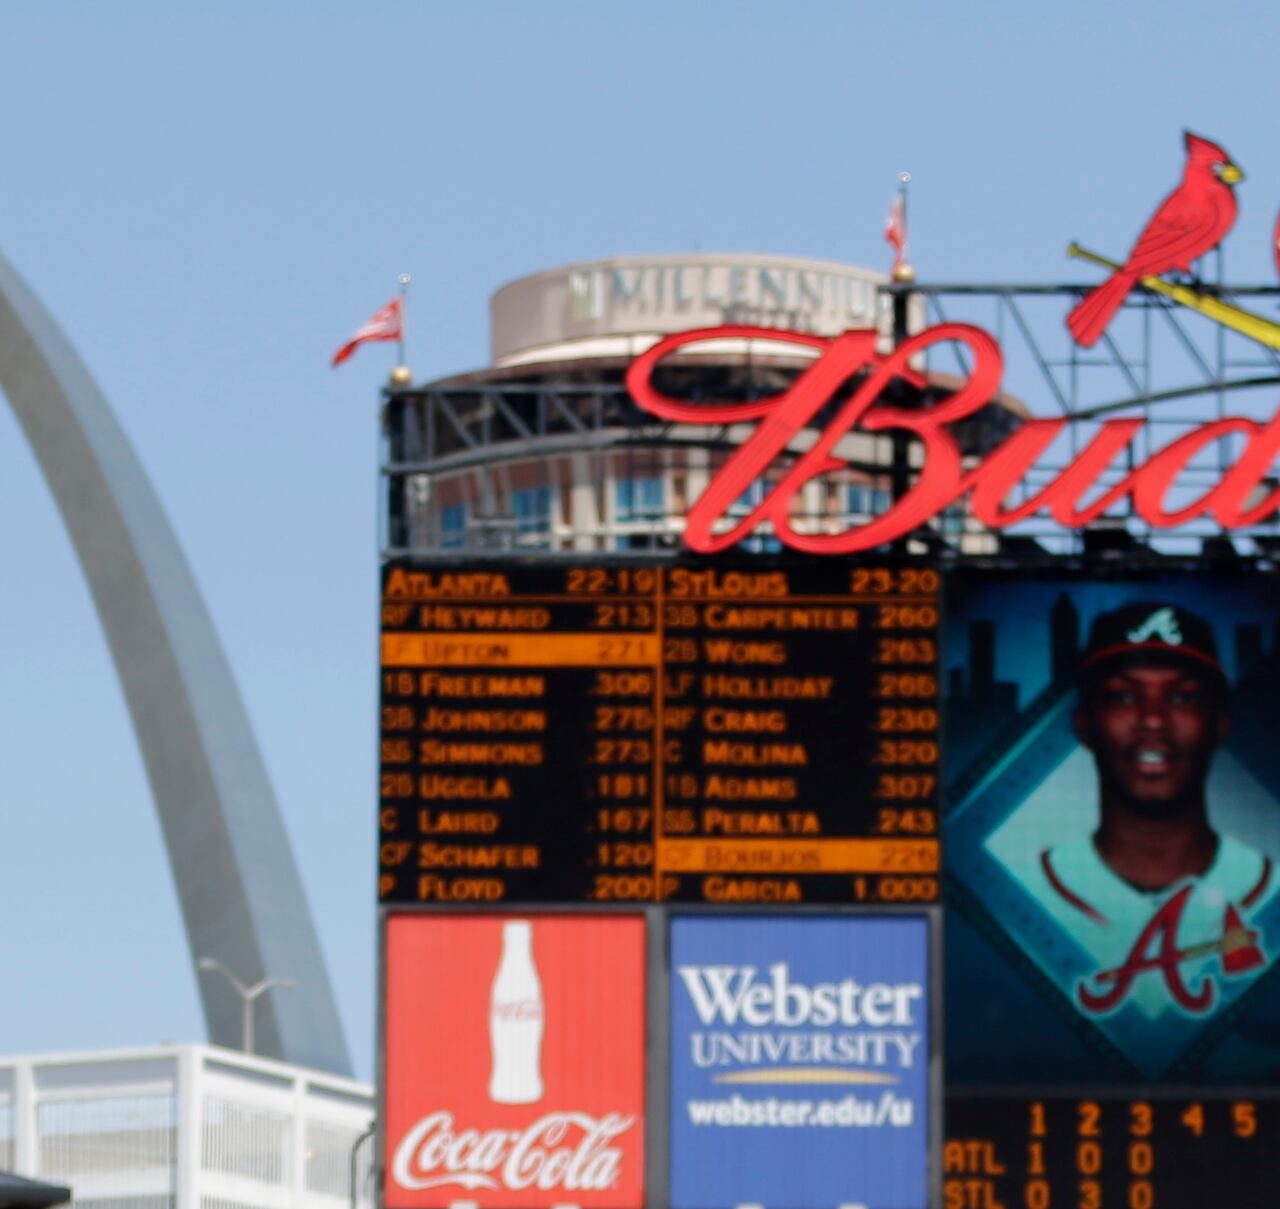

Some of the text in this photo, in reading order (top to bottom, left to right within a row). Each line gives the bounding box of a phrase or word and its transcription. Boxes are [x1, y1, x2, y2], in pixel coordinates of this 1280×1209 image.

[612, 266, 888, 318] MILLENNIU
[386, 568, 654, 596] ATLANTA 22-19
[852, 568, 941, 594] 23-20
[422, 605, 551, 628] HEYWARD
[704, 605, 859, 630] CARPENTER
[423, 638, 510, 660] UPTON
[705, 639, 787, 664] WONG
[422, 673, 545, 697] FREEMAN
[704, 673, 833, 698] HOLLIDAY
[422, 707, 546, 731] JOHNSON
[704, 707, 787, 732] CRAIG
[420, 740, 544, 765] SIMMONS
[704, 740, 809, 765] MOLINA
[421, 774, 511, 799] UGGLA
[705, 775, 798, 799] ADAMS
[419, 808, 500, 834] LAIRD
[704, 808, 821, 833] PERALTA
[873, 808, 936, 832] .243
[419, 842, 541, 868] SCHAFER
[419, 874, 505, 900] FLOYD
[704, 876, 802, 901] GARCIA
[680, 963, 922, 1026] Webster
[691, 1031, 922, 1068] UNIVERSITY
[687, 1094, 914, 1128] webster.edu/u
[1028, 1102, 1047, 1138] 1
[1078, 1102, 1102, 1138] 2
[1129, 1103, 1154, 1138] 3
[1181, 1103, 1205, 1138] 4
[1232, 1102, 1257, 1138] 5
[392, 1110, 636, 1190] Coca-Cola
[943, 1140, 1006, 1175] ATL
[1028, 1142, 1045, 1175] 1
[1078, 1142, 1102, 1175] 0
[1129, 1142, 1154, 1175] 0
